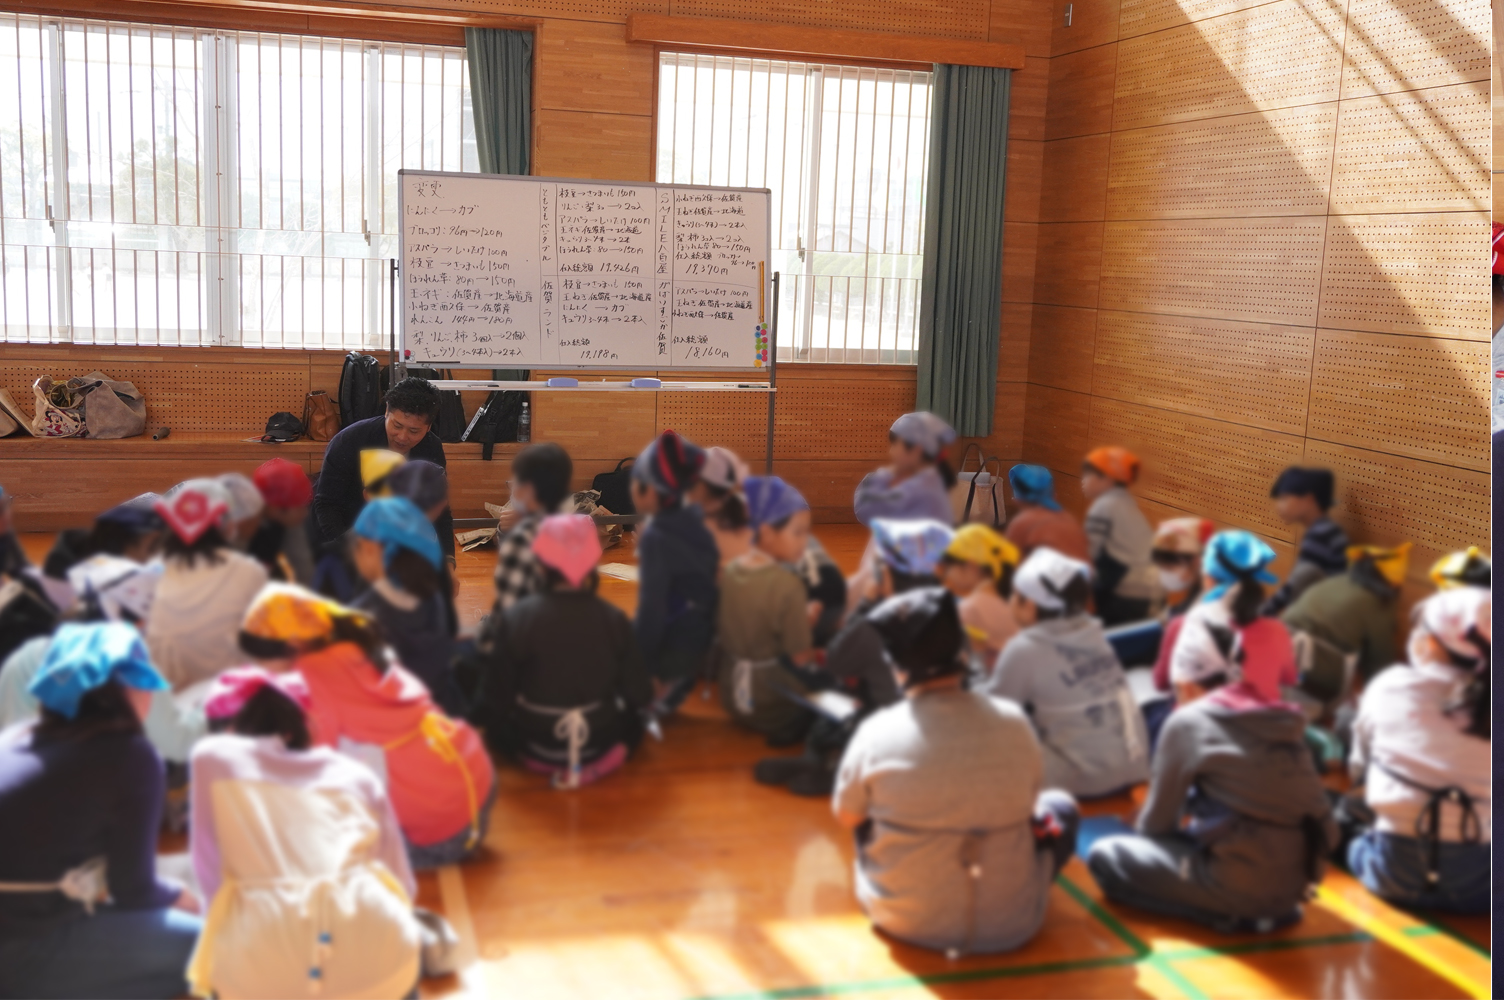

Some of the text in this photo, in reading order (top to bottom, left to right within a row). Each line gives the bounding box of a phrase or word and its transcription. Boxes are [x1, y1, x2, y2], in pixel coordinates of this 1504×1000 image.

[412, 178, 444, 199] 変更
[617, 189, 636, 198] 150円
[406, 204, 479, 216] にんにく カブ
[559, 214, 588, 224] アスパラ
[630, 216, 651, 225] 100円
[480, 227, 503, 238] 120円
[408, 243, 508, 257] アスパラ しいたけ 100円
[623, 245, 644, 254] 150円
[730, 244, 751, 253] 150円
[453, 259, 486, 271] さつまいも
[489, 260, 510, 271] 150円
[491, 275, 516, 288] 150円
[624, 281, 643, 289] 150円
[729, 289, 749, 297] 100円
[481, 303, 511, 314] 佐賀産
[541, 280, 555, 339] 佐賀ランド
[563, 303, 588, 312] にんにく
[410, 313, 513, 325] れんこん 144円 180円
